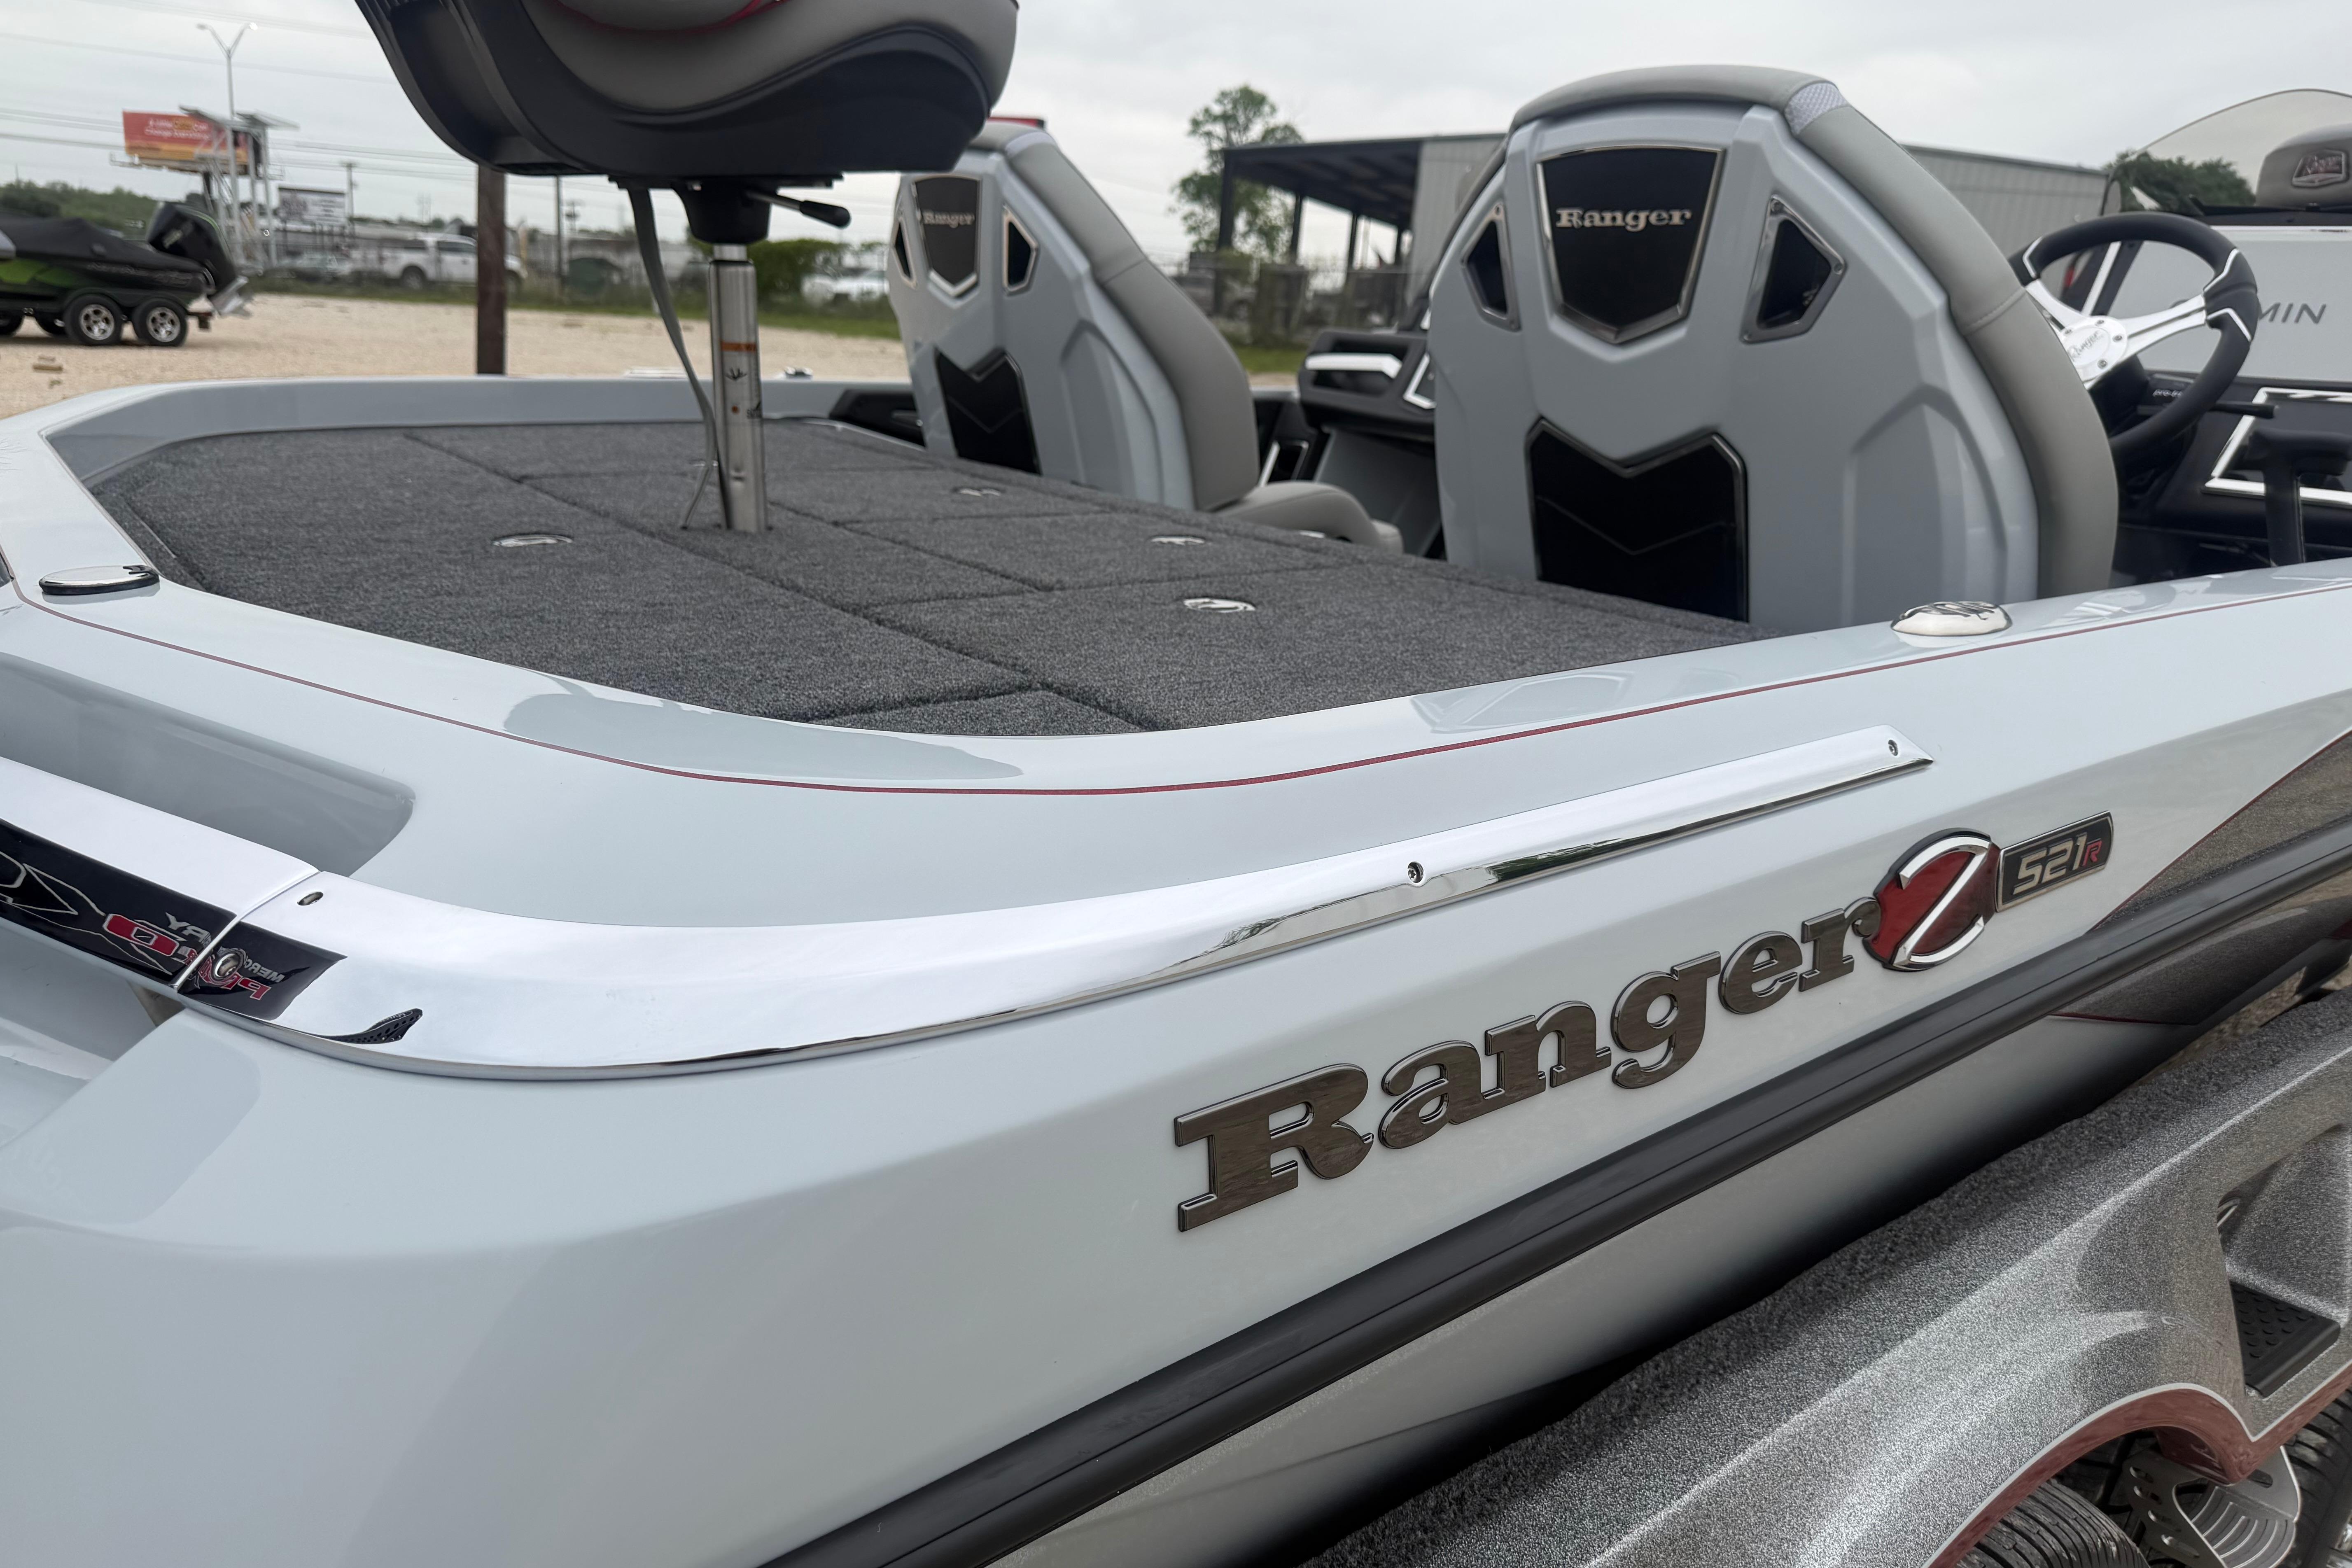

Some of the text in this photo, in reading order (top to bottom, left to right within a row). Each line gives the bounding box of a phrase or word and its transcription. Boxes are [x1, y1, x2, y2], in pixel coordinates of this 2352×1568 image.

[922, 210, 975, 229] Ranger
[1555, 207, 1692, 232] Ranger
[2258, 303, 2327, 324] MIN
[1174, 896, 1882, 1233] Ranger
